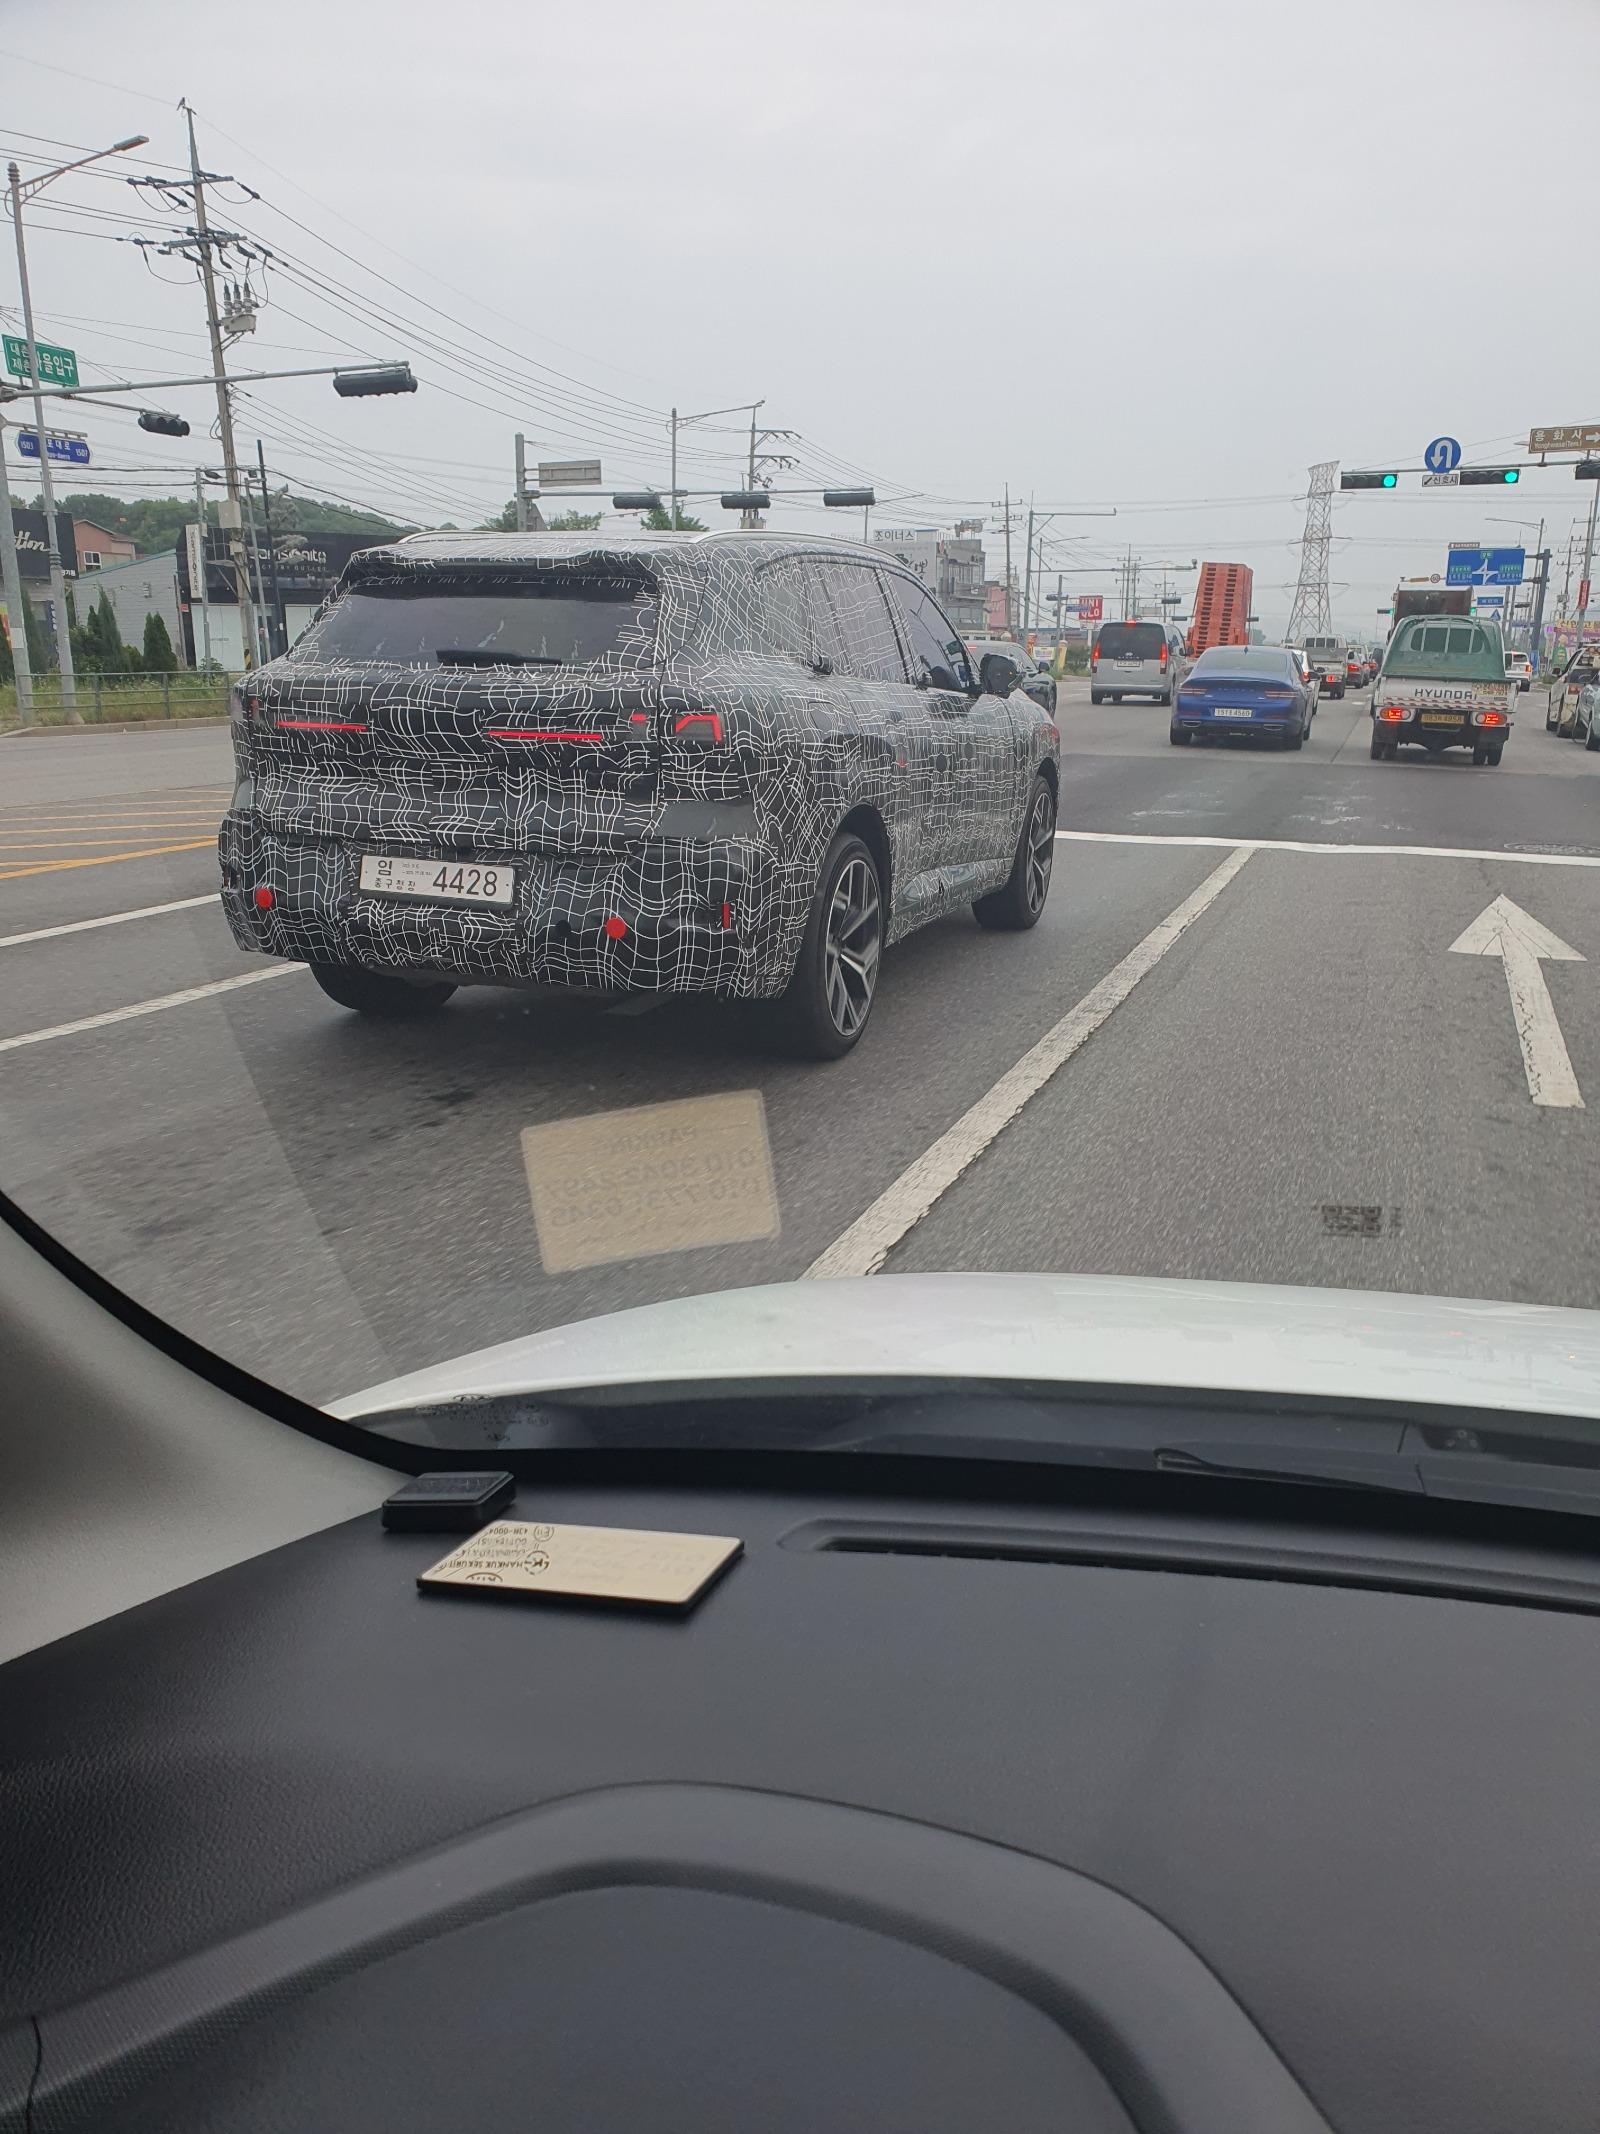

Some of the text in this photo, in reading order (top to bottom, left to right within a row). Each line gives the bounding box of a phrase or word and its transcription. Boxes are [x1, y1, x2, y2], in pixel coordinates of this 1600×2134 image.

[36, 350, 75, 378] 을입구
[1534, 430, 1583, 442] 용화사
[46, 438, 71, 451] 포대로
[1433, 474, 1458, 485] 신호시
[874, 530, 915, 541] 조이너스
[1414, 688, 1477, 700] HYUNDAI
[378, 860, 393, 876] 임
[433, 866, 498, 897] 4428
[449, 1560, 523, 1569] HANKUK SEKURIT
